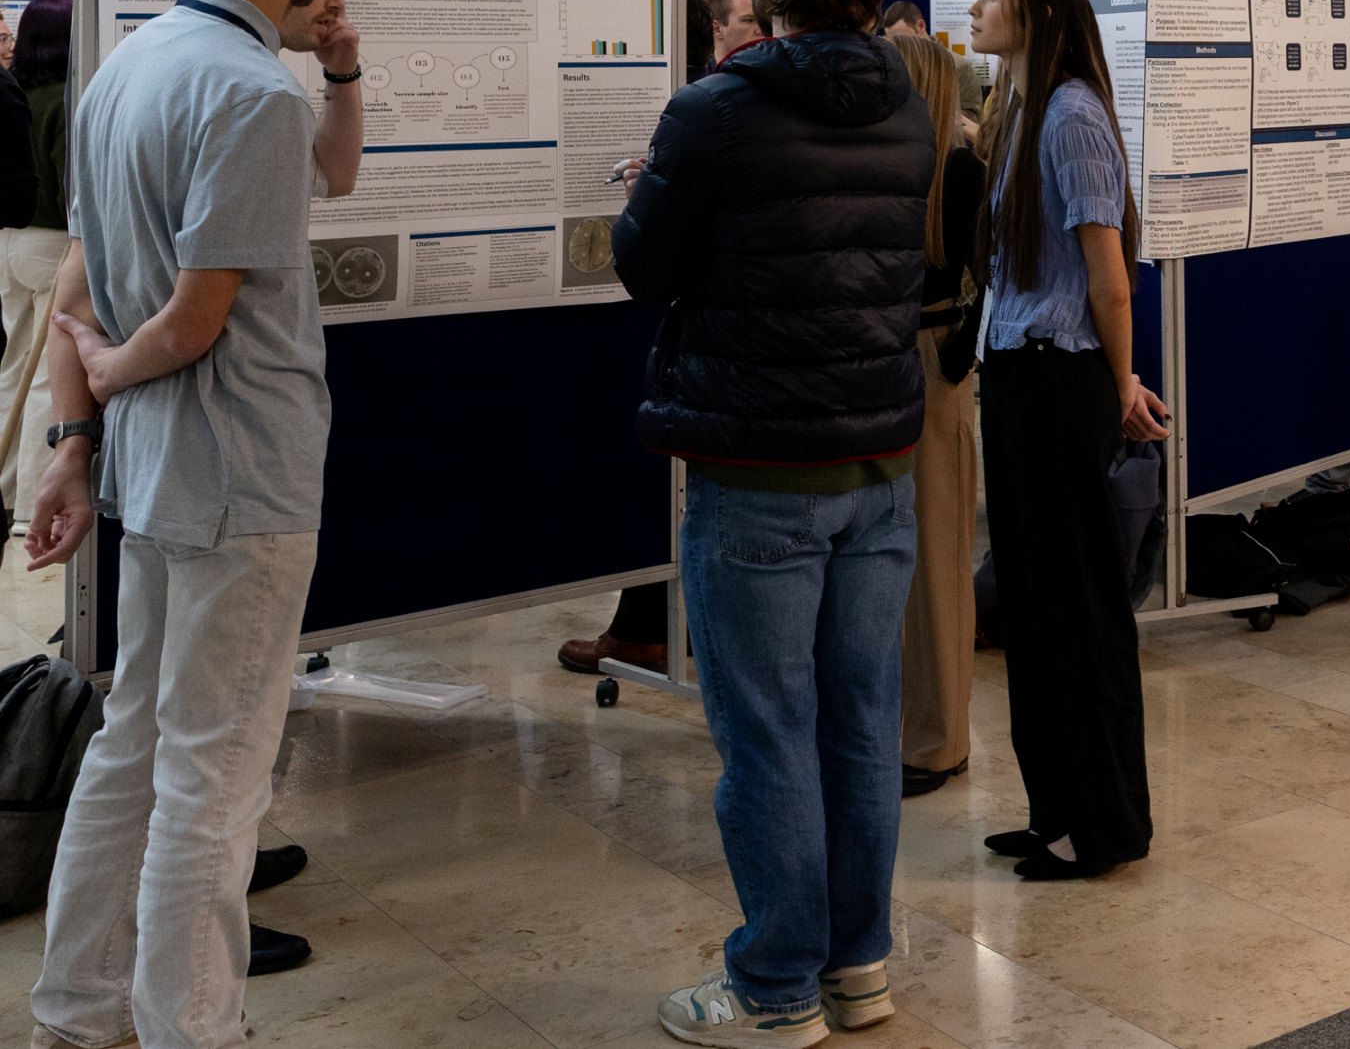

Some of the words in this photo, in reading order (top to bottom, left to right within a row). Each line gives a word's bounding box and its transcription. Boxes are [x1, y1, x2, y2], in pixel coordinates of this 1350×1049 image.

[563, 74, 590, 82] Results
[415, 239, 441, 248] Citations
[708, 995, 737, 1026] N
